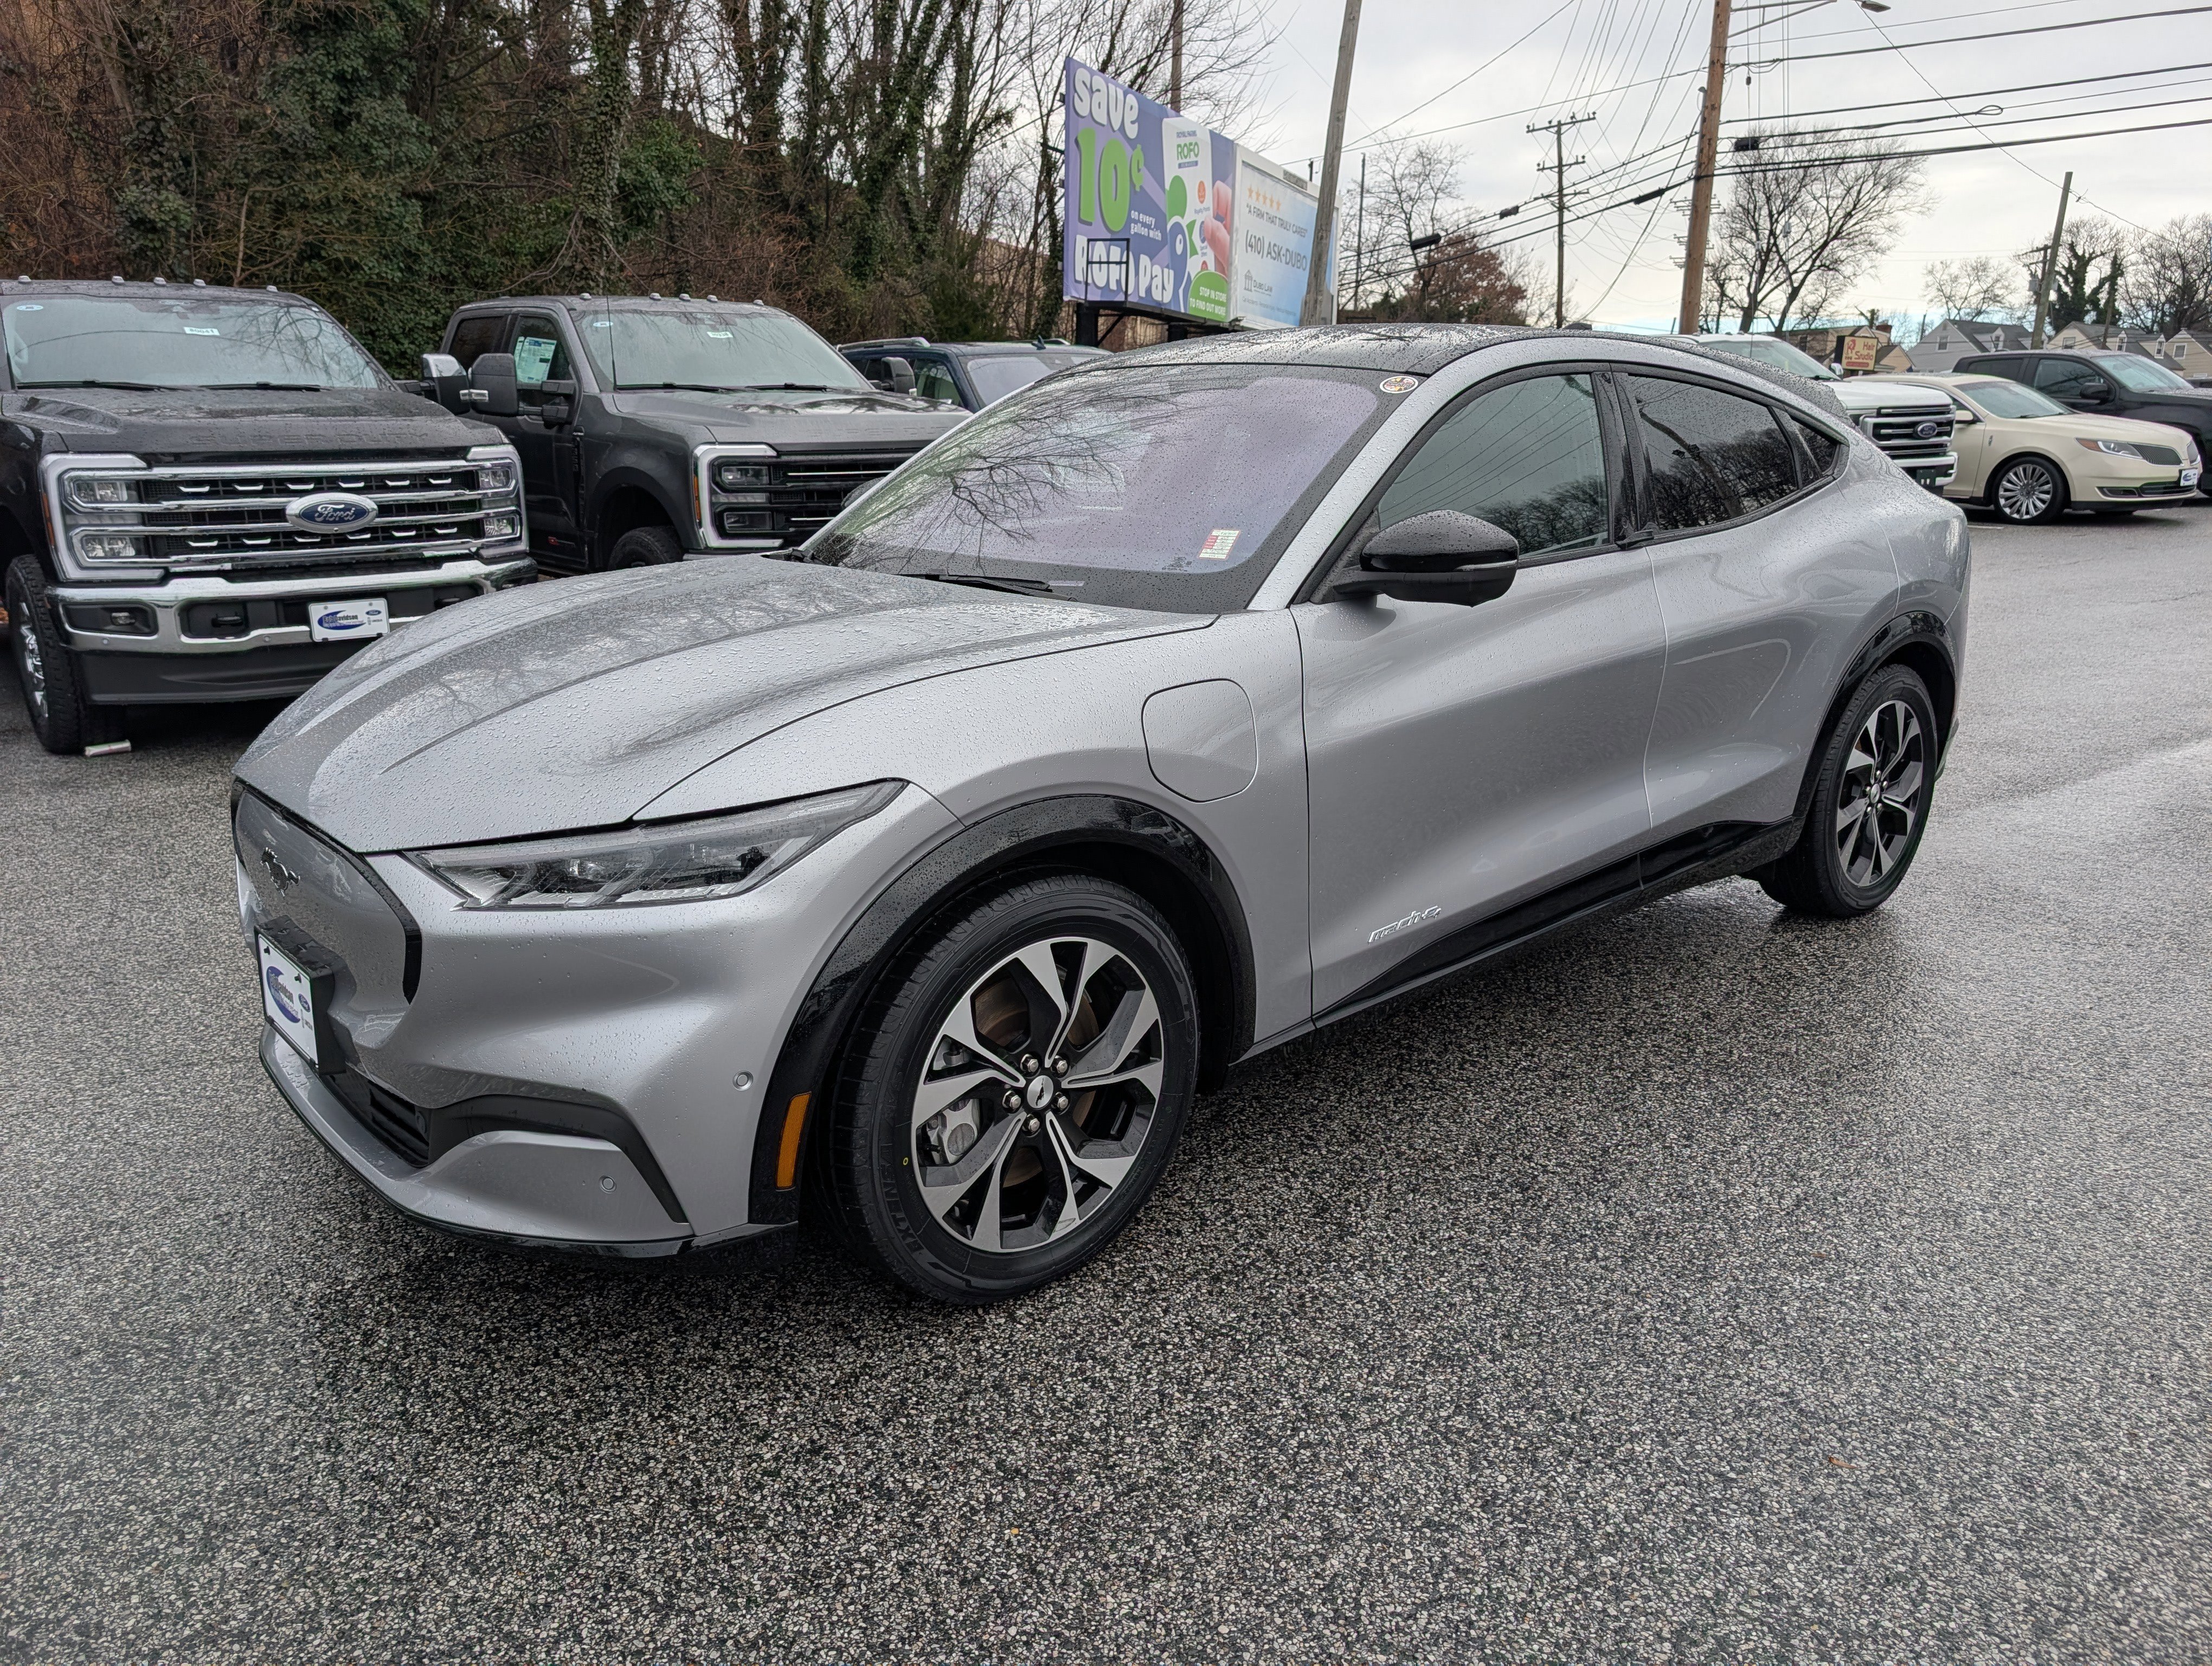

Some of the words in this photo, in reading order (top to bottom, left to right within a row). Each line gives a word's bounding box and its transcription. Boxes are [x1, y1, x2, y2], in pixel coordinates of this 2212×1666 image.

[1176, 142, 1199, 160] ROFO
[1131, 210, 1139, 219] on
[1140, 212, 1156, 228] every
[1252, 206, 1265, 221] FIRM
[1265, 212, 1277, 226] THAT
[1278, 217, 1291, 231] TRULY
[1130, 223, 1148, 236] gallon
[1149, 228, 1162, 241] with
[1245, 229, 1264, 259] (410)
[1266, 241, 1308, 271] ASK-DUBO
[1139, 254, 1174, 303] Pay
[1863, 341, 1875, 351] Hair
[314, 504, 356, 522] Ford
[335, 614, 358, 623] Davidson
